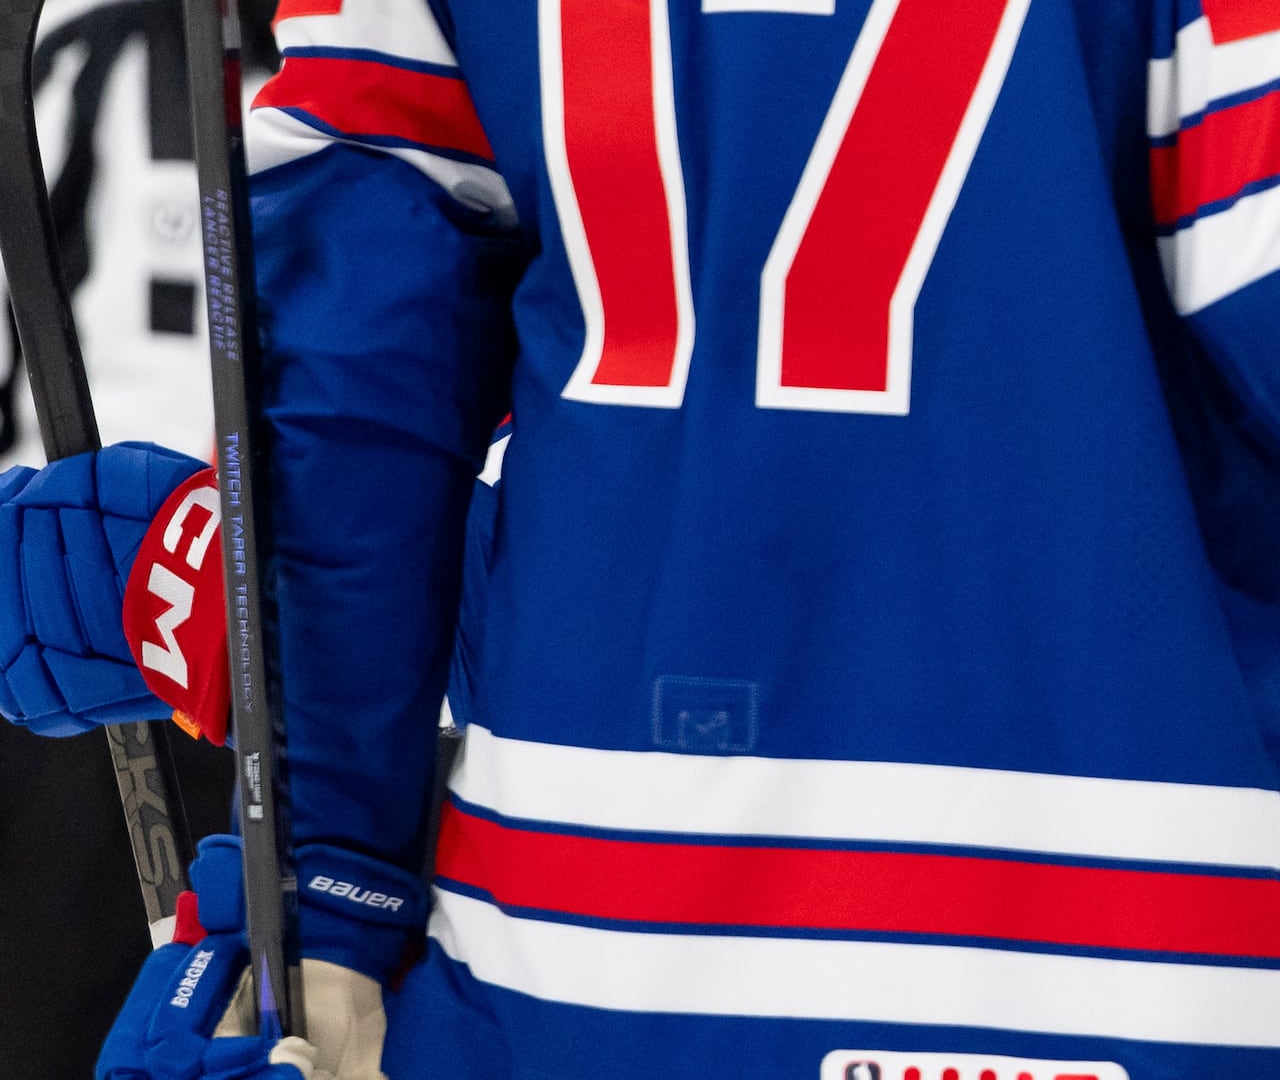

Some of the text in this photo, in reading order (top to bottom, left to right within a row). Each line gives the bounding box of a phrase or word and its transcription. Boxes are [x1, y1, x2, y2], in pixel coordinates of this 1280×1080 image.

[216, 189, 239, 361] REACTIVE RELEASE
[141, 485, 222, 689] CM
[225, 431, 253, 713] TWITCH TAPER TECHNOLOGY
[170, 949, 216, 1009] BORGEN
[308, 875, 405, 912] BAUER
